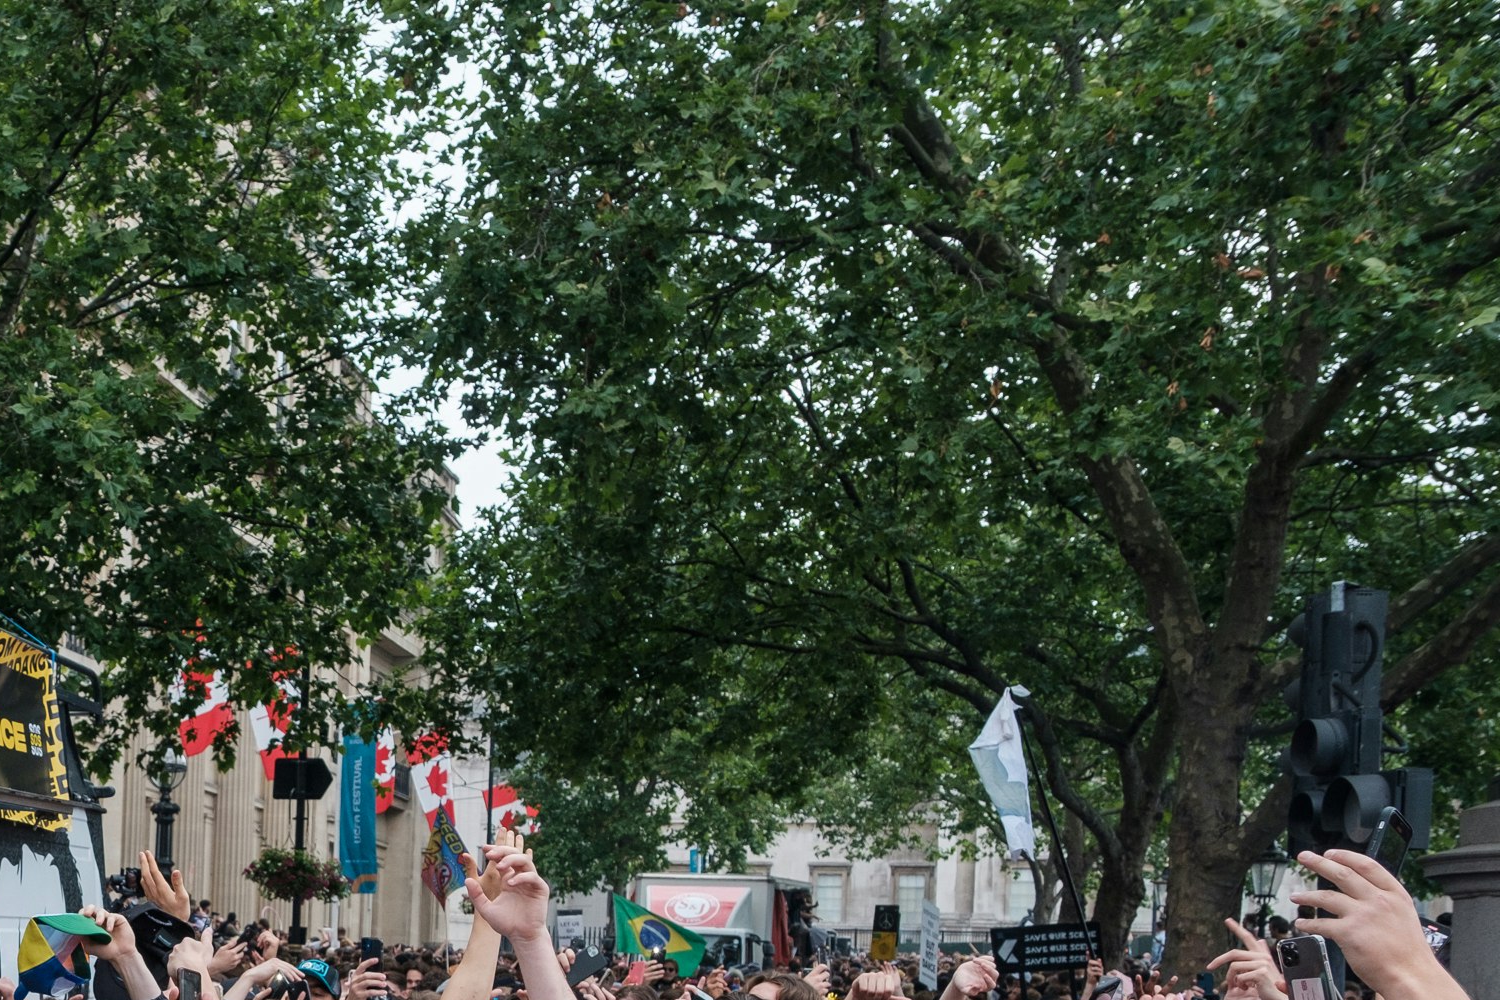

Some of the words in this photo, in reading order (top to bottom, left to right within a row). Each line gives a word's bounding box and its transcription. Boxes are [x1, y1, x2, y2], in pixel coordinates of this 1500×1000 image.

[352, 756, 363, 812] FESTIVAL
[1024, 933, 1047, 942] SAVE
[1048, 931, 1067, 940] OUR
[1025, 945, 1048, 954] SAVE
[1049, 944, 1068, 953] OUR
[1024, 957, 1048, 966] SAVE
[1050, 956, 1068, 964] OUR
